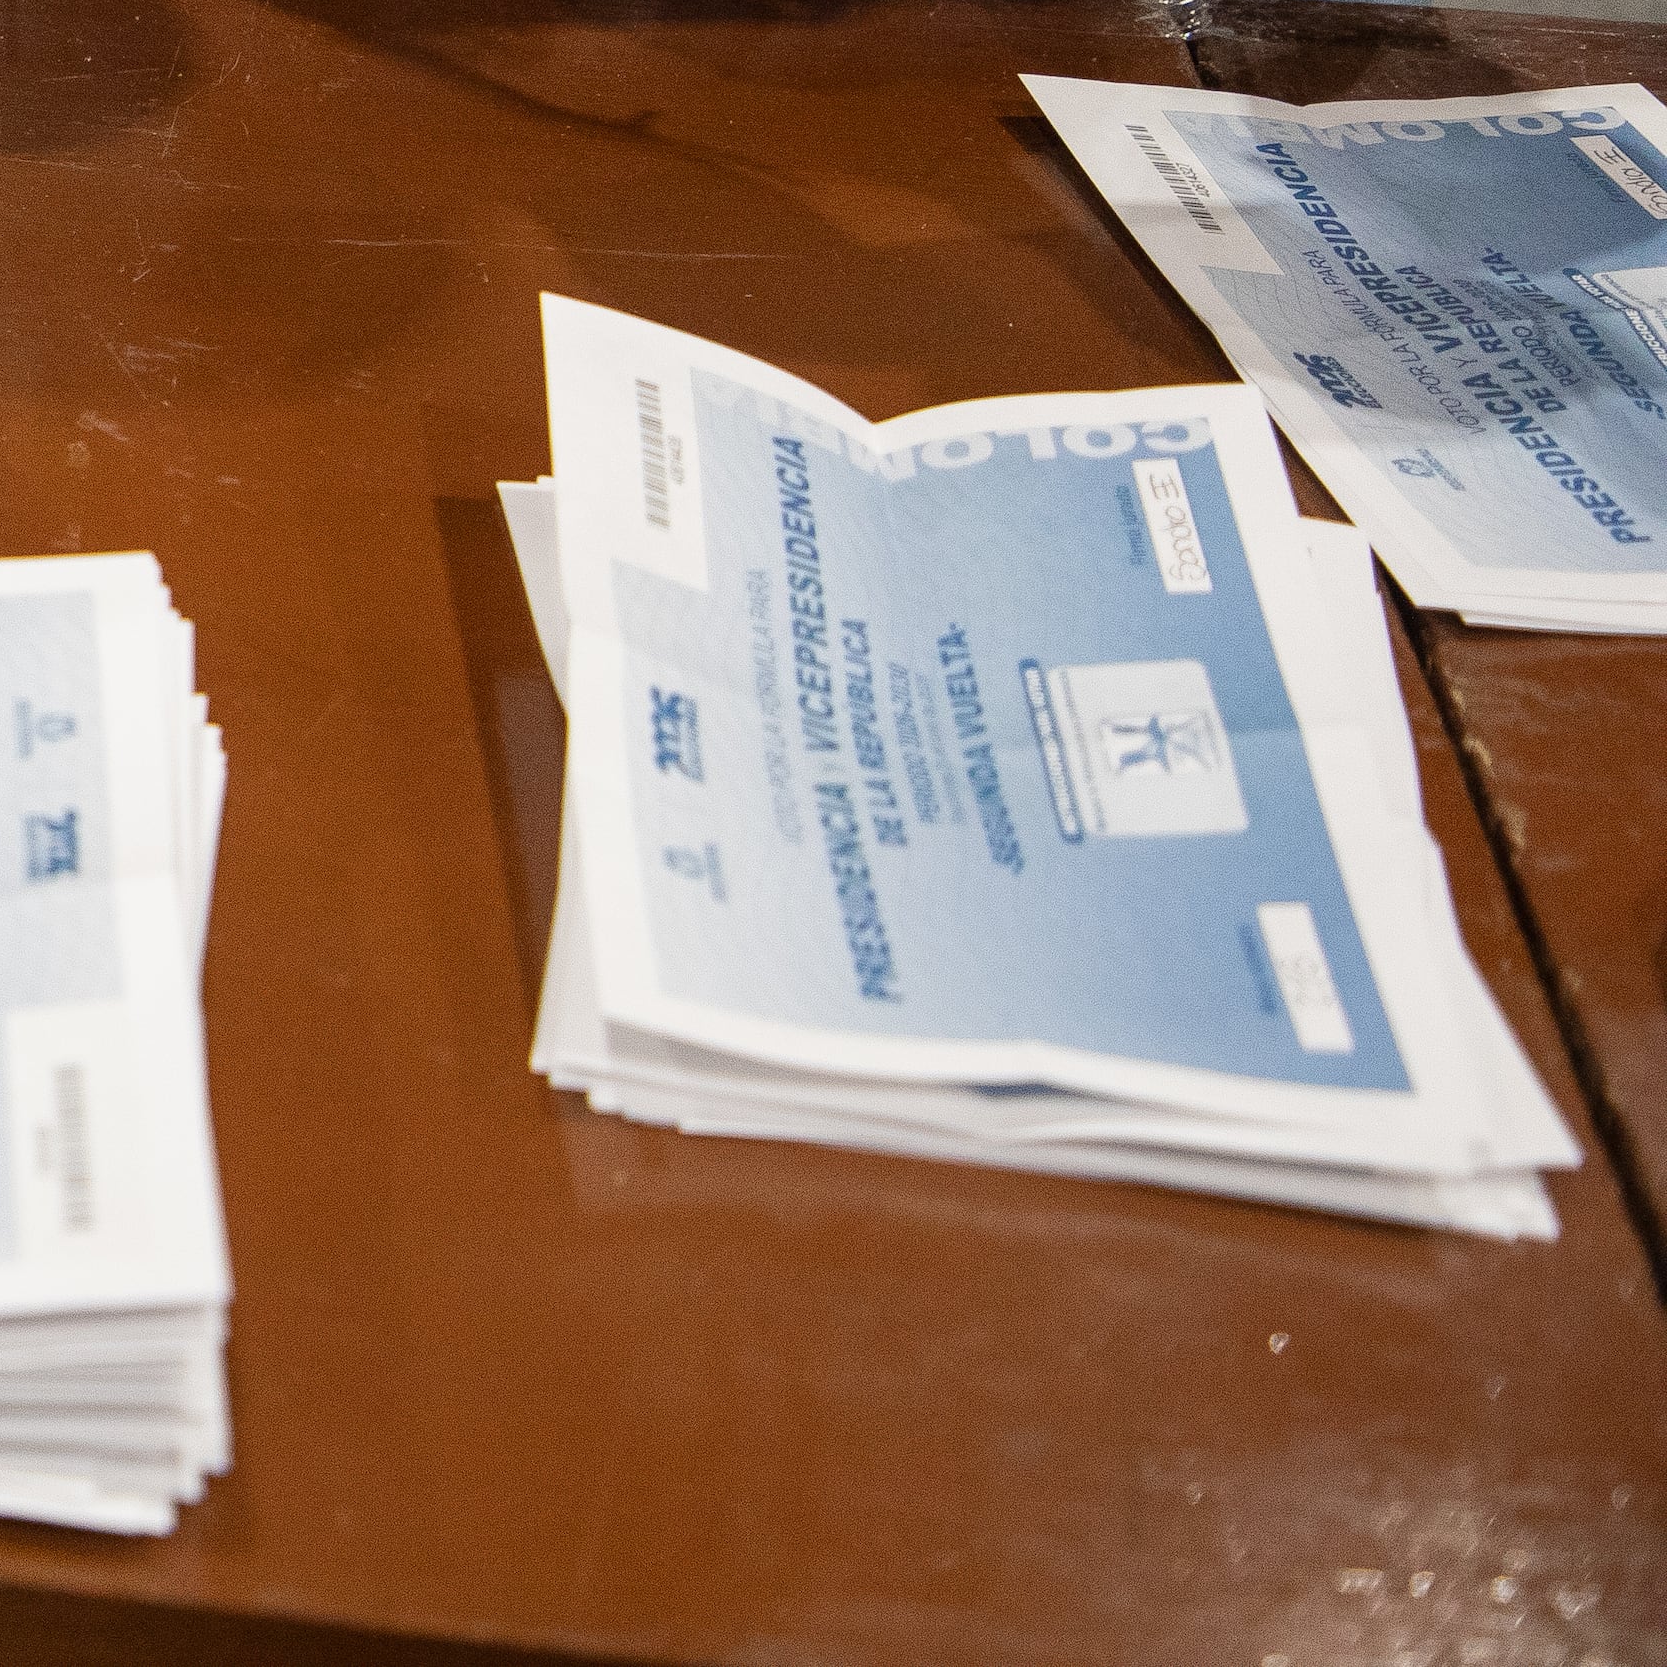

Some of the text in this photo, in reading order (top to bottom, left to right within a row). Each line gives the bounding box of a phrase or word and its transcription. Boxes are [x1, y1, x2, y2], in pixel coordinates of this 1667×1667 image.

[1256, 142, 1653, 544] PRESIDENCIA Y VICEPRESIDENCIA
[1302, 248, 1488, 435] VOTO POR LA PARA
[1511, 325, 1583, 387] PERIODO
[1293, 350, 1368, 408] 2026
[1499, 356, 1569, 415] DE LA
[746, 569, 771, 620] PARA
[771, 436, 905, 1005] PRESIDENCIA VICEPRESIDENCIA
[864, 778, 898, 810] LA
[874, 813, 909, 850] DE
